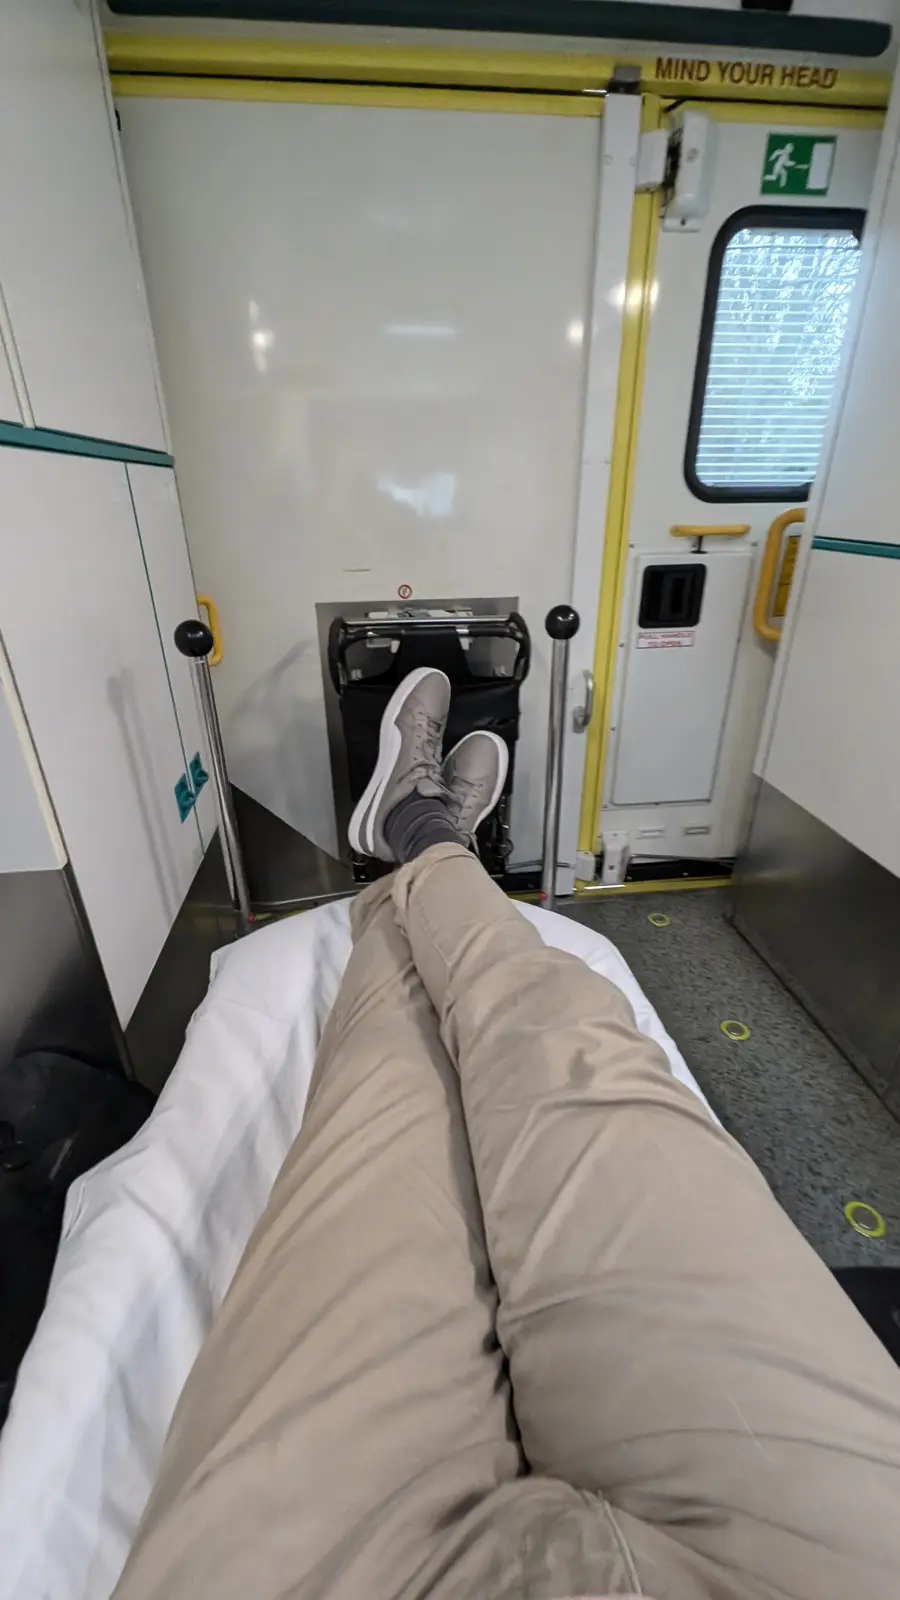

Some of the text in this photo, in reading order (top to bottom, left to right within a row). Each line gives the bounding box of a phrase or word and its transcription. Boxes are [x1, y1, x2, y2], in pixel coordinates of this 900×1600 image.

[655, 57, 838, 88] MIND YOUR HEAD
